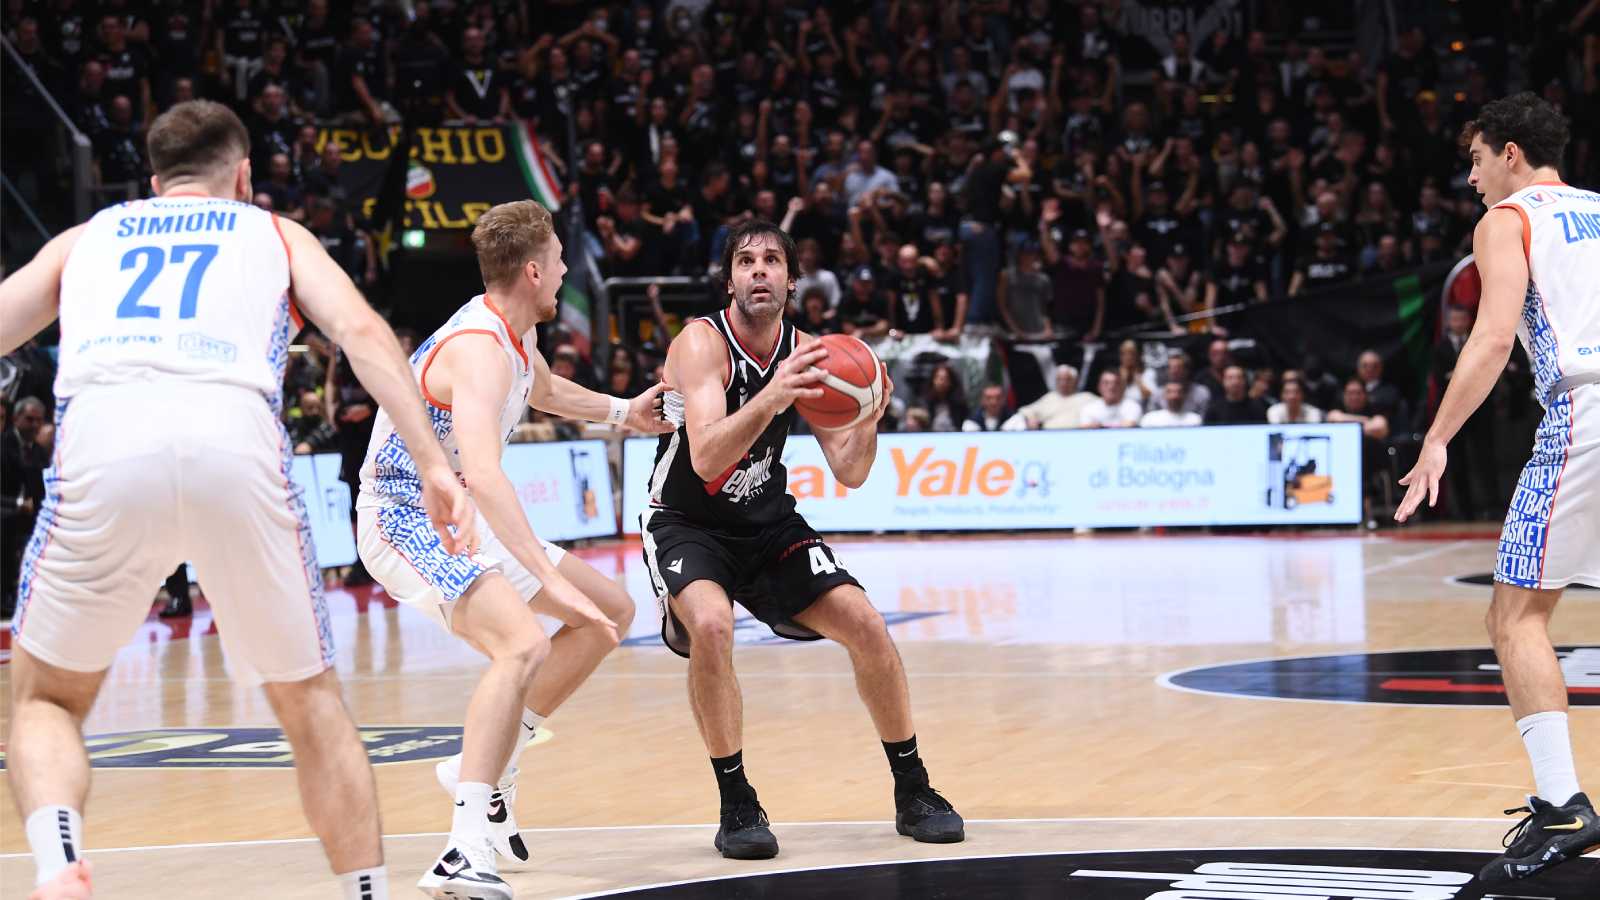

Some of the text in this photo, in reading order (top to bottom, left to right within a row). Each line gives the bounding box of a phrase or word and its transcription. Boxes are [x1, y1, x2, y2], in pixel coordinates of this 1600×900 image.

[117, 211, 237, 237] SIMIONI
[116, 244, 219, 319] 27
[889, 447, 1015, 497] Yale
[1089, 465, 1215, 492] di Bologna
